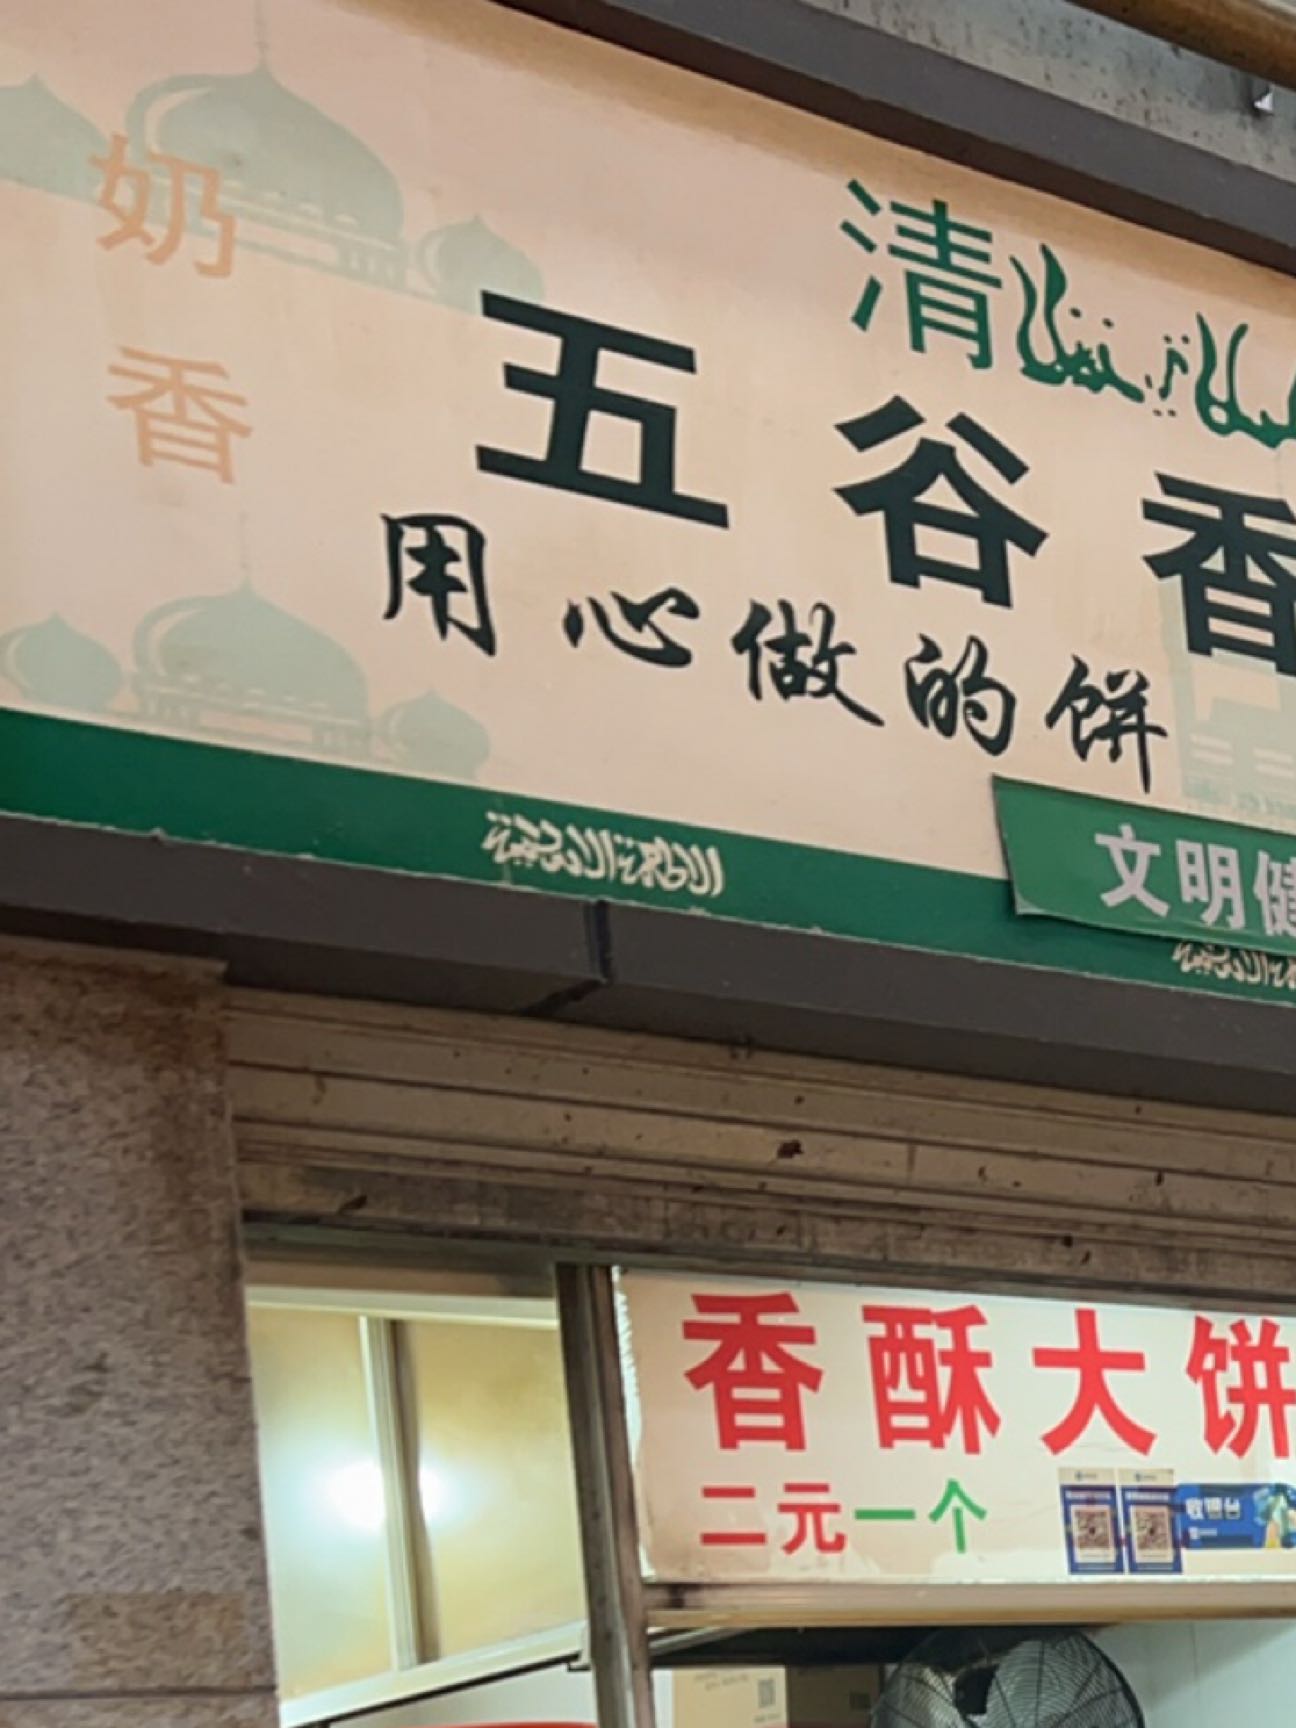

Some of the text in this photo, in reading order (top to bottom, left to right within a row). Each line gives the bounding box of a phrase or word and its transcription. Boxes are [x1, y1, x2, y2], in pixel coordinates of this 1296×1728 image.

[89, 132, 254, 485] 奶香
[840, 178, 1003, 369] 清
[381, 513, 1168, 793] 用心做的饼
[701, 1479, 988, 1554] 二元一个
